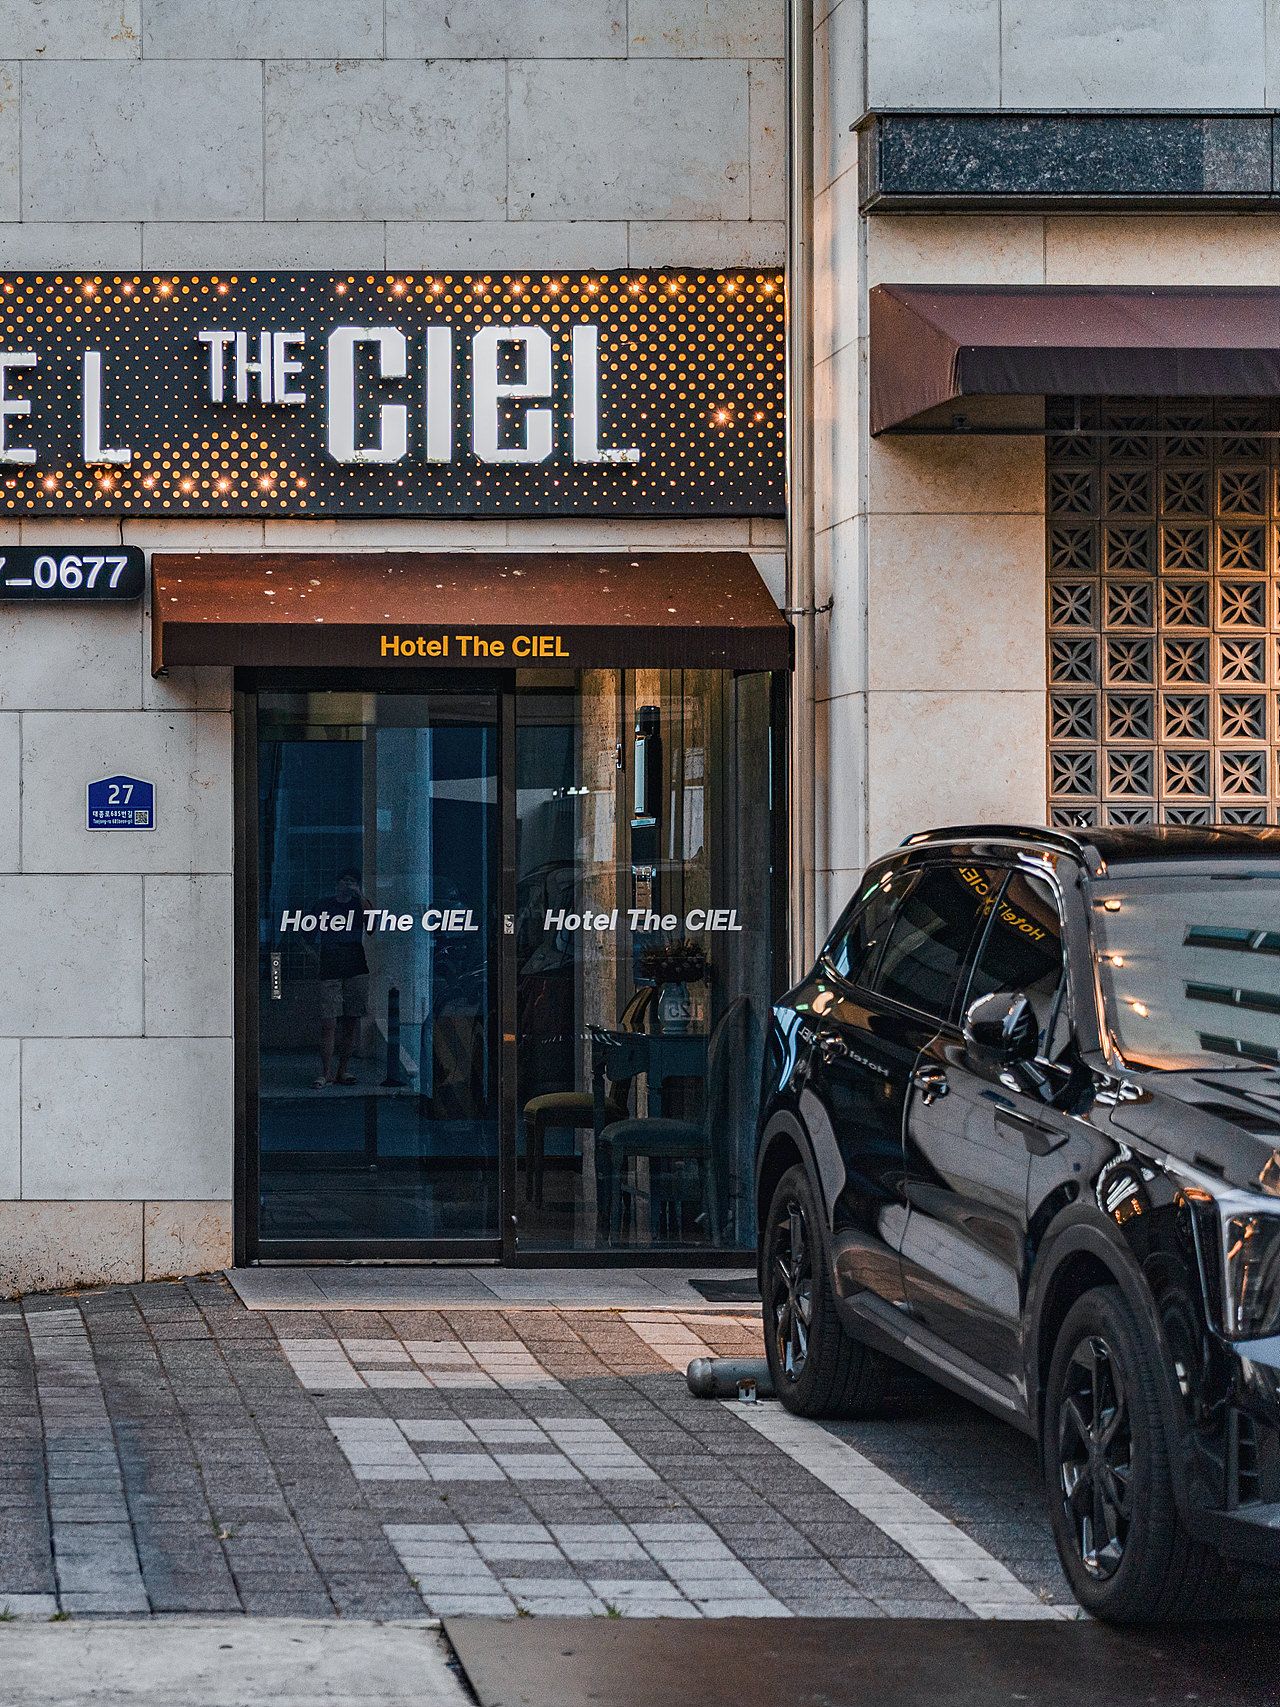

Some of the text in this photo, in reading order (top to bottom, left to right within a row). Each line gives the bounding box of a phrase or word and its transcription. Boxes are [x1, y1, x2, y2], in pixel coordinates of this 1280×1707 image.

[198, 330, 306, 405] THE
[379, 634, 570, 658] Hotel The CIEL
[108, 784, 134, 805] 27
[279, 909, 479, 933] Hotel The CIEL
[543, 908, 743, 932] Hotel The CIEL
